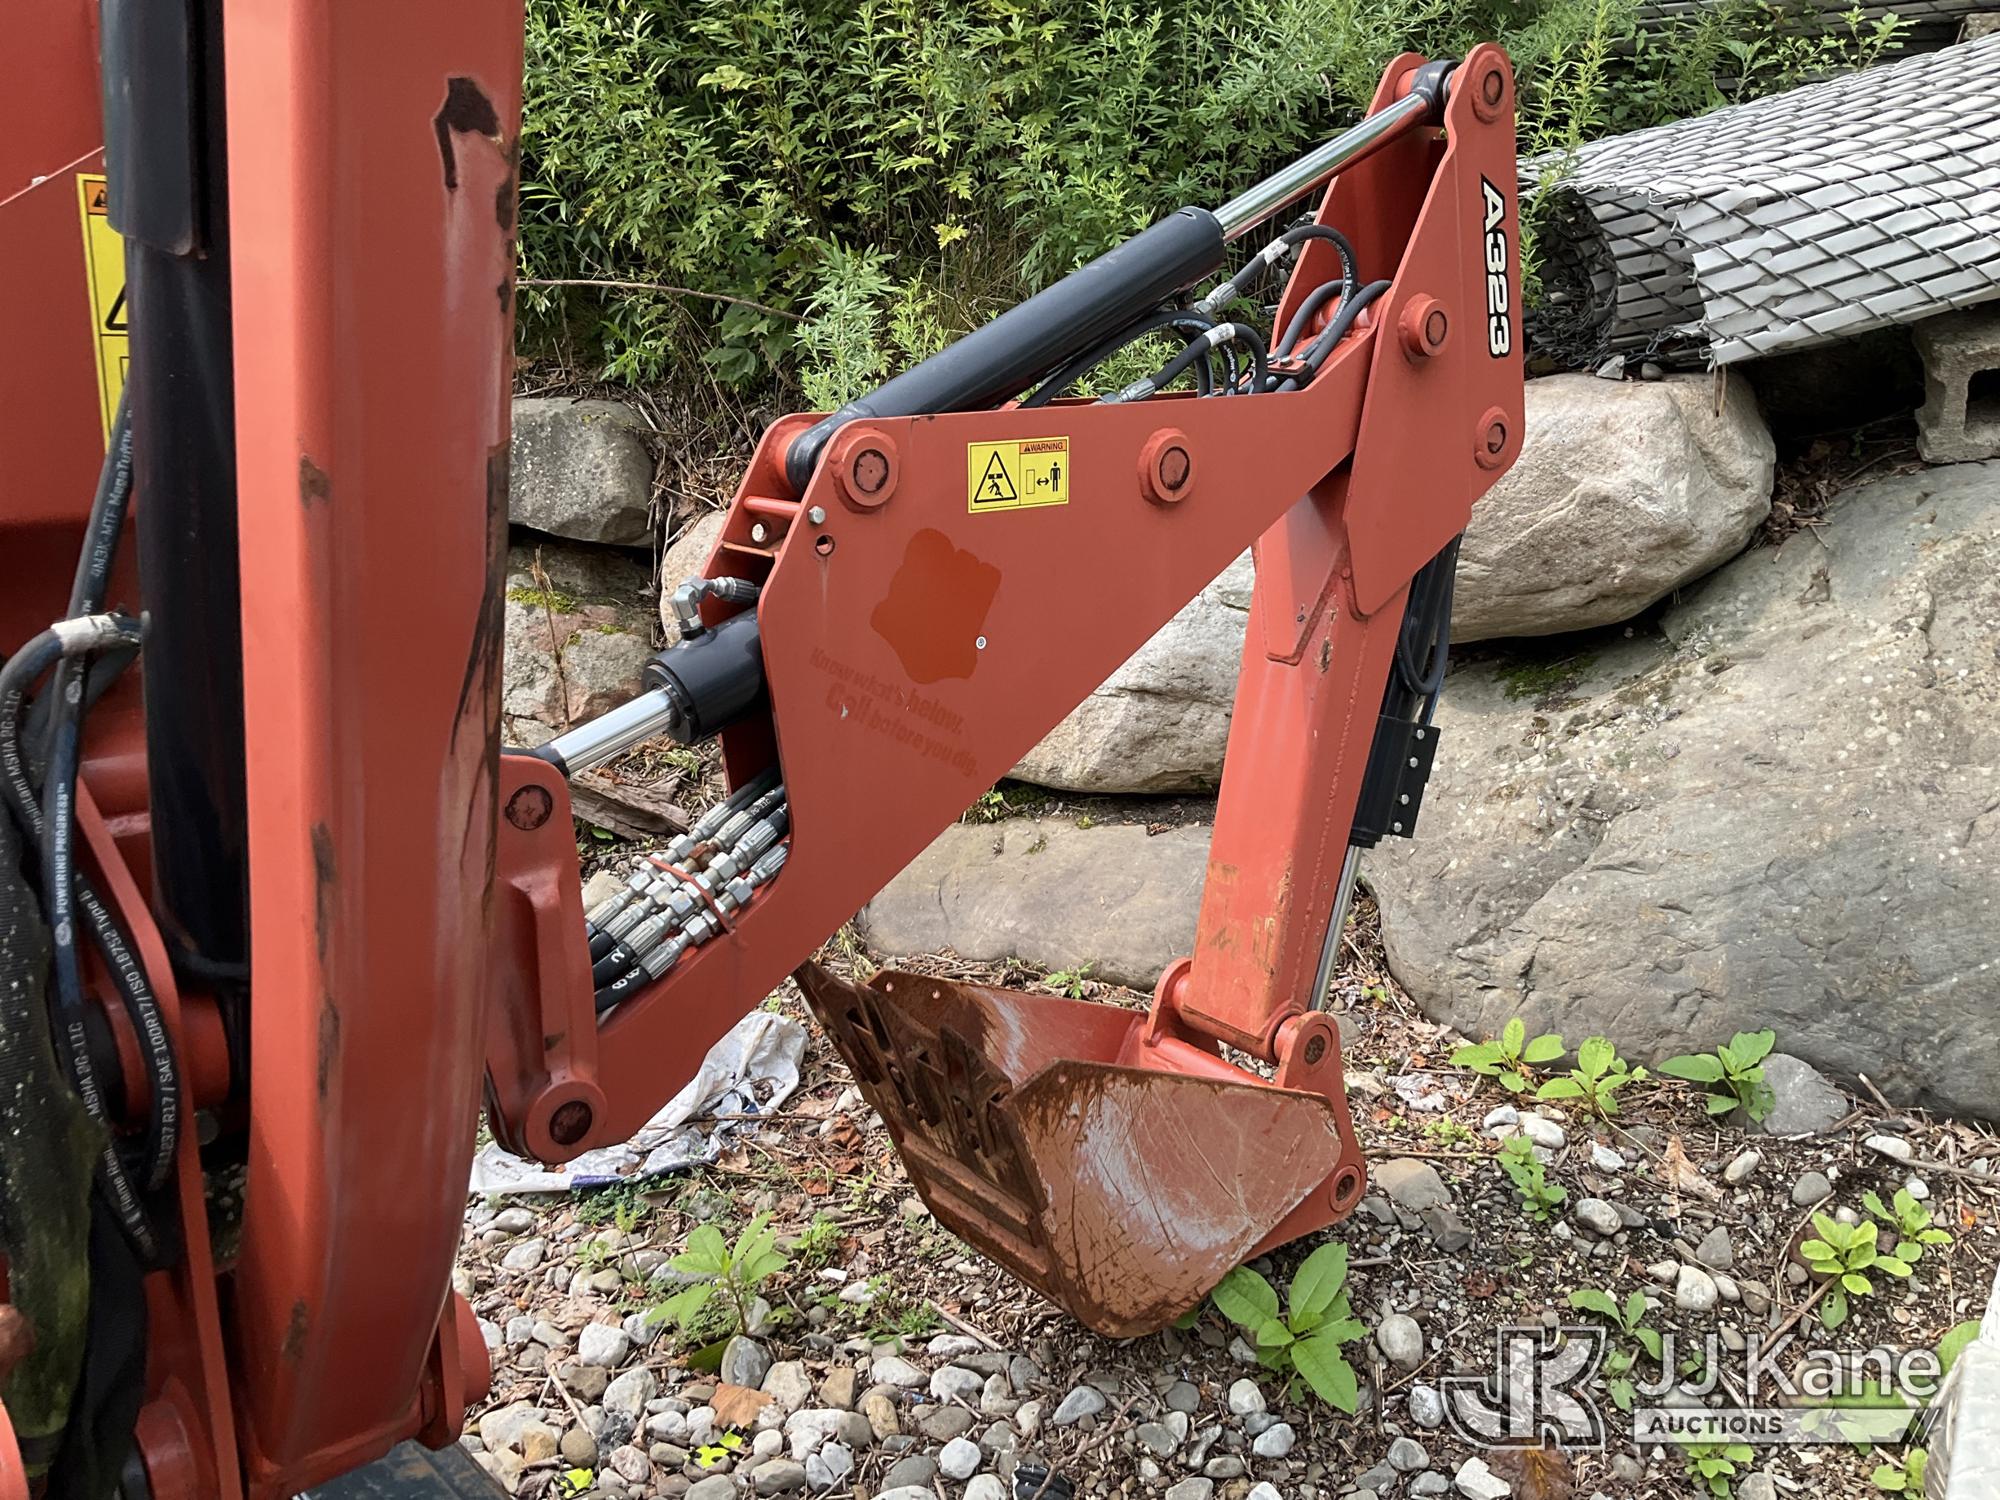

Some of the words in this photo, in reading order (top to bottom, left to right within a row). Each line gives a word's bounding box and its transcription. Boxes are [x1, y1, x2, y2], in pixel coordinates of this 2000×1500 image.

[1481, 174, 1511, 358] A323
[1030, 442, 1063, 452] WARNING
[809, 648, 855, 681] Know
[826, 682, 875, 724] Call
[868, 710, 924, 748] before
[923, 735, 953, 762] you
[55, 851, 69, 914] POWERING
[87, 900, 111, 932] Type
[103, 928, 135, 973] 18752
[125, 971, 146, 995] ISO
[156, 1054, 174, 1083] SAE
[80, 1075, 100, 1117] MSHA
[161, 1096, 176, 1124] R17
